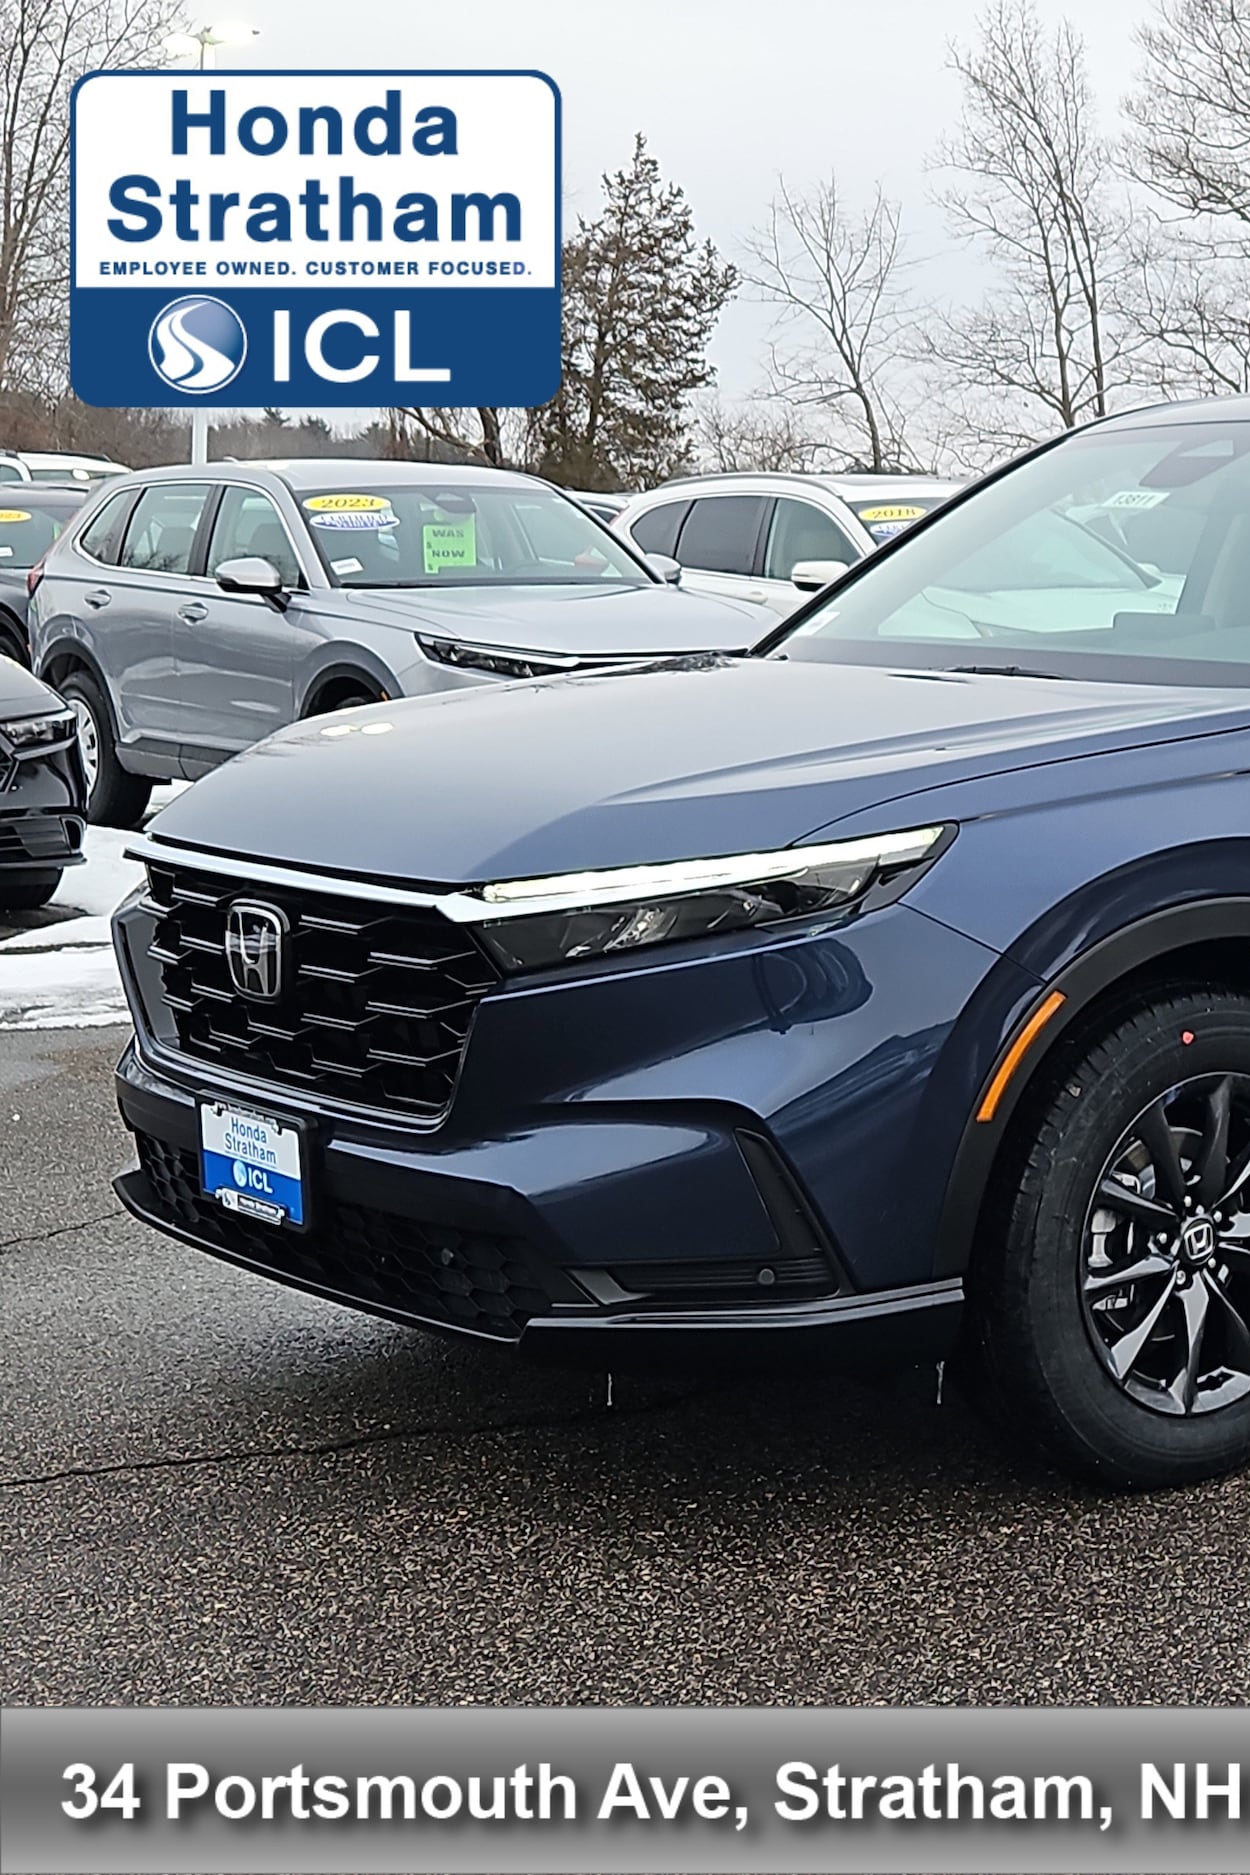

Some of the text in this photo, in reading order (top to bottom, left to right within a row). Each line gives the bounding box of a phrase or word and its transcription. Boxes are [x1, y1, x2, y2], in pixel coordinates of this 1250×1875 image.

[321, 497, 375, 509] 2023
[432, 529, 464, 538] WAS
[432, 550, 465, 558] NOW
[231, 1117, 267, 1143] Honda
[224, 1132, 277, 1164] Stratham
[247, 1167, 273, 1194] ICL
